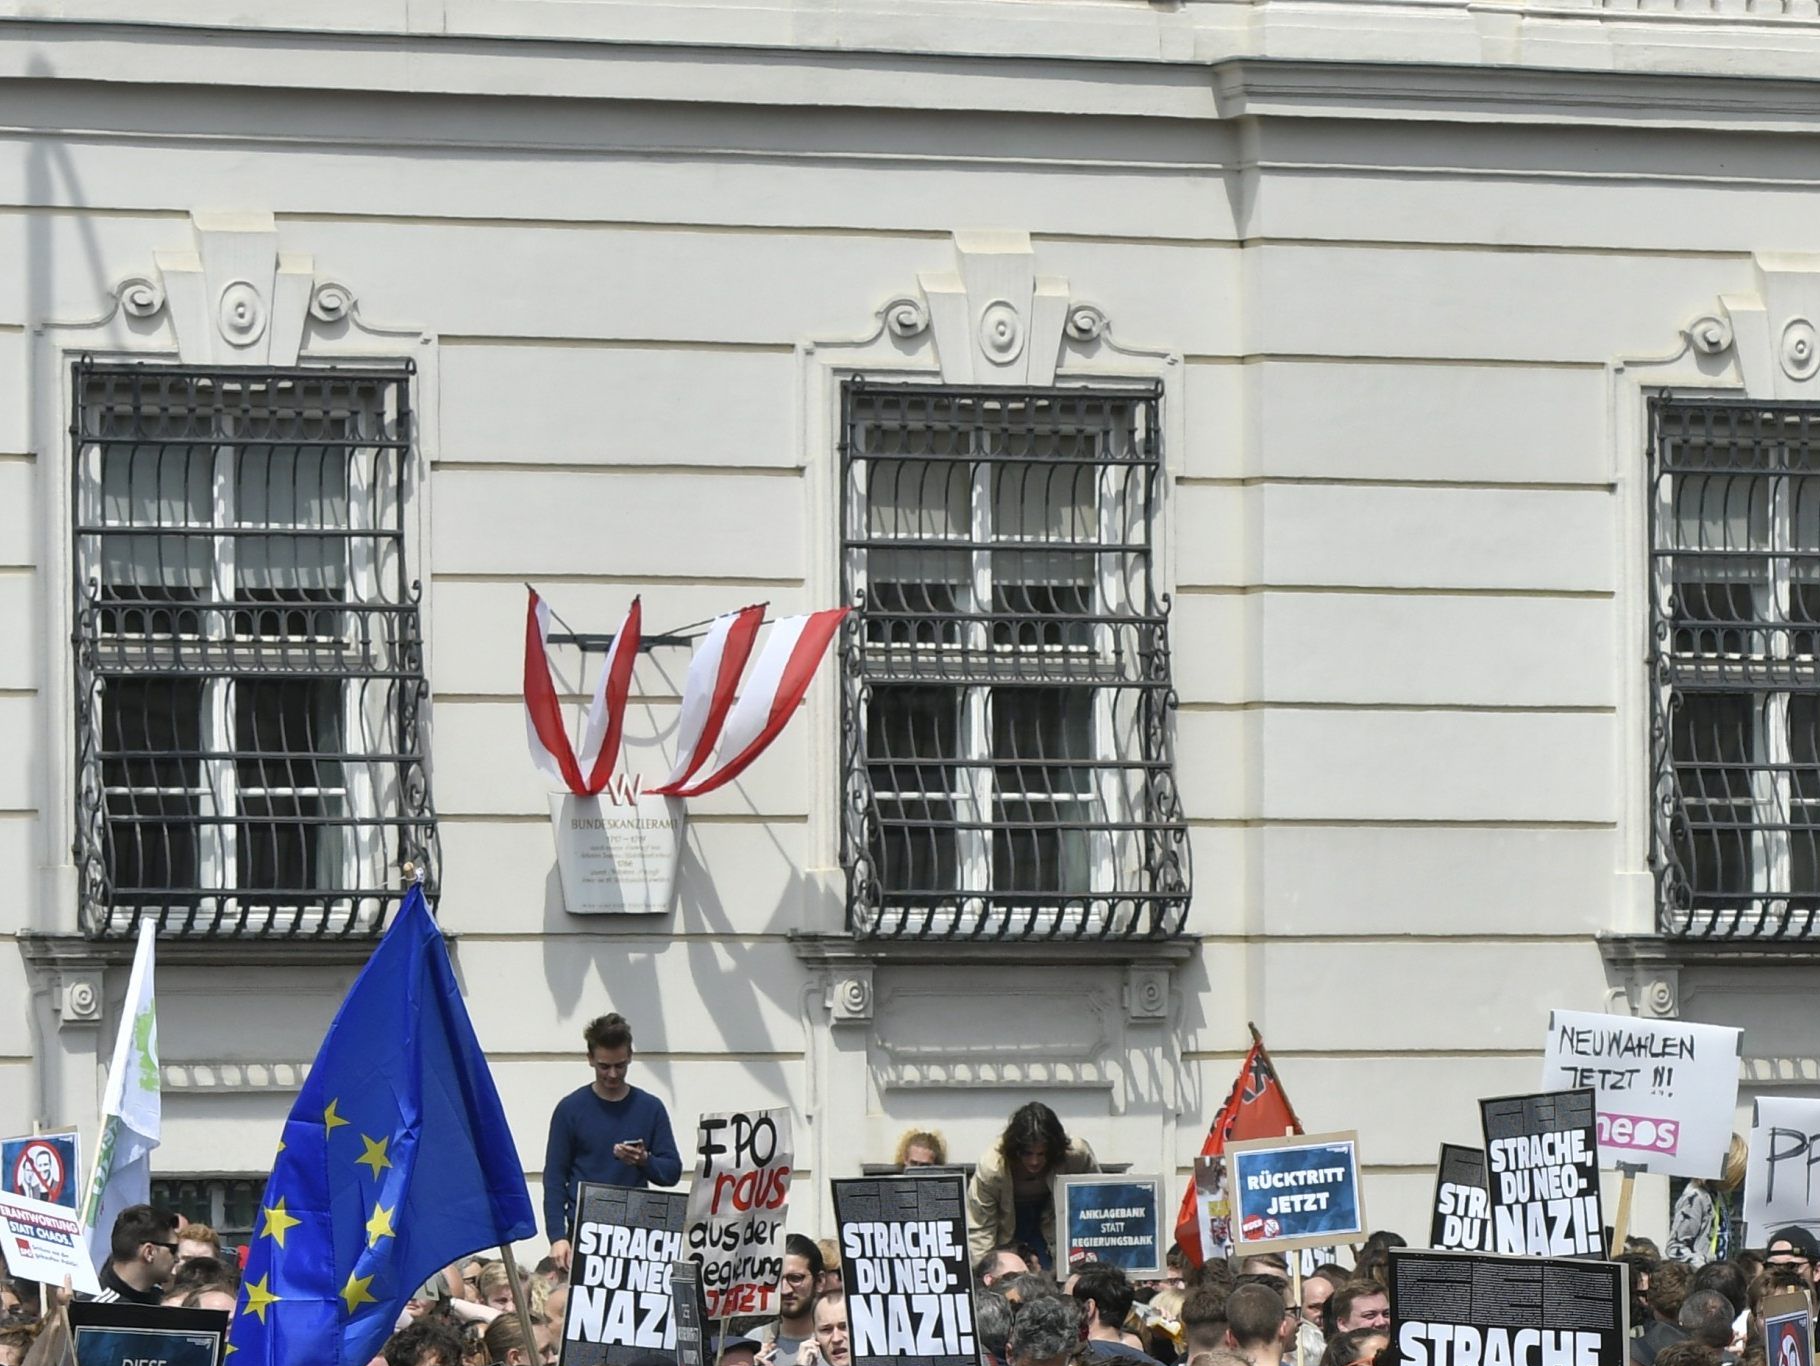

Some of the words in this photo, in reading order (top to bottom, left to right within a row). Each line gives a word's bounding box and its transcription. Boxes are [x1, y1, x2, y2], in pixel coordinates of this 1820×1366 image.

[1559, 1024, 1695, 1061] NEUWAHLEN
[1561, 1066, 1641, 1090] JETZT
[698, 1111, 777, 1178] FPÖ
[1596, 1116, 1677, 1149] neos
[1490, 1129, 1593, 1173] STRACHE,
[711, 1165, 789, 1215] raus
[1247, 1167, 1345, 1191] RÜCKTRITT
[1500, 1169, 1530, 1205] DU
[1533, 1163, 1588, 1201] NEO-
[0, 1206, 77, 1234] ERANTWORTUNG
[1079, 1207, 1146, 1220] ANKLAGEBANK
[1266, 1192, 1330, 1215] JETZT
[579, 1222, 683, 1262] STRACH
[688, 1218, 739, 1251] aus
[744, 1215, 781, 1246] der
[843, 1220, 963, 1261] STRACHE,
[1071, 1234, 1153, 1247] REGIERUNGSBANK
[1101, 1222, 1124, 1233] STATT
[1495, 1196, 1602, 1257] NAZI!
[584, 1255, 617, 1289] DU
[855, 1258, 889, 1294] DU
[893, 1258, 958, 1294] NEO-
[850, 1293, 976, 1357] NAZI!
